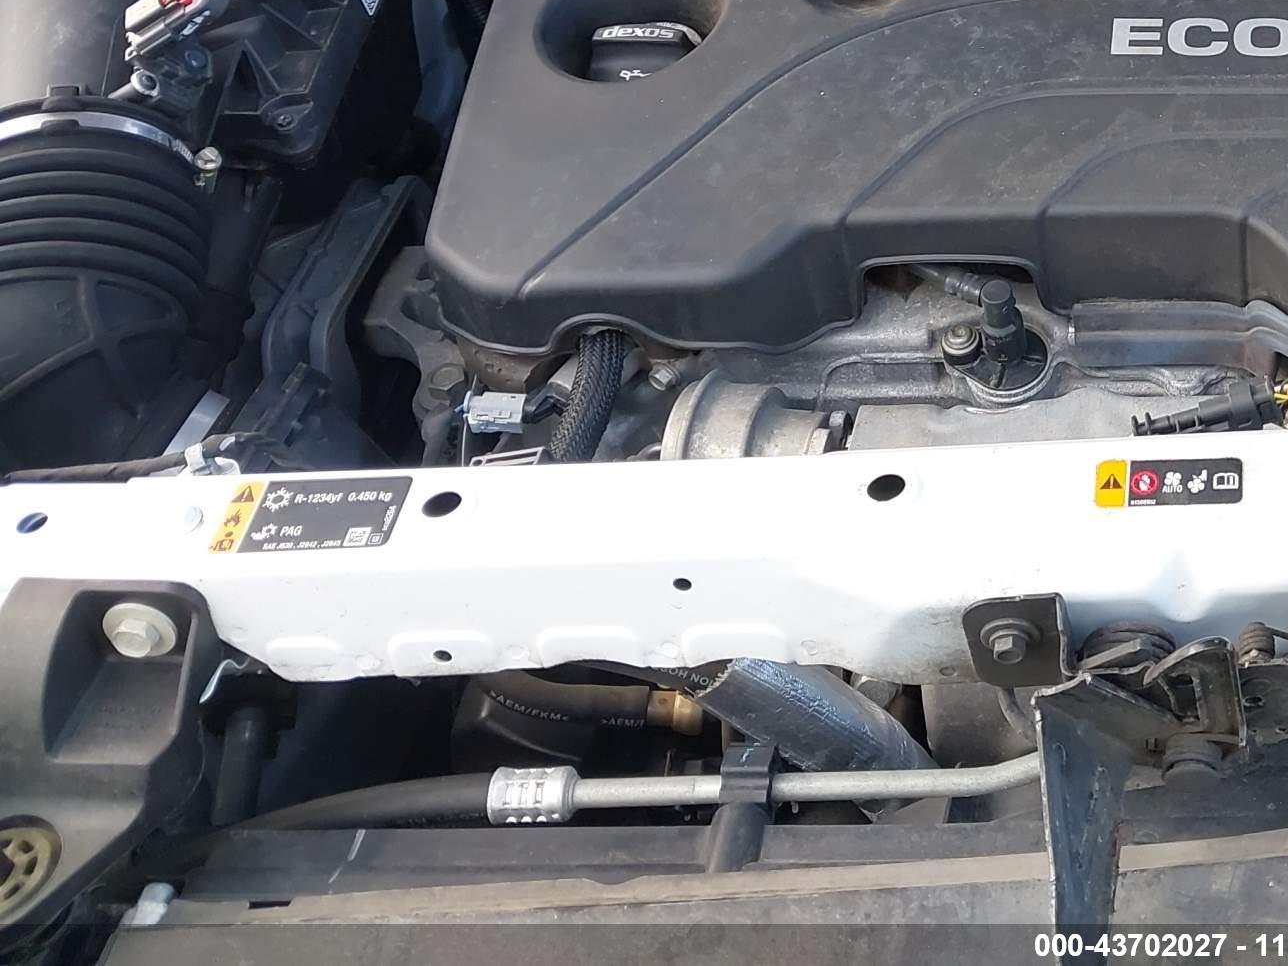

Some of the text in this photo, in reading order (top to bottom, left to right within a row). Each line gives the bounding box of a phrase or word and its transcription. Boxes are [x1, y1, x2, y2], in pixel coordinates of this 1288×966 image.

[602, 25, 675, 39] dexos
[1162, 484, 1183, 493] AUTO
[294, 490, 392, 504] R-1234yf 0.450 kg
[279, 525, 303, 537] PAG
